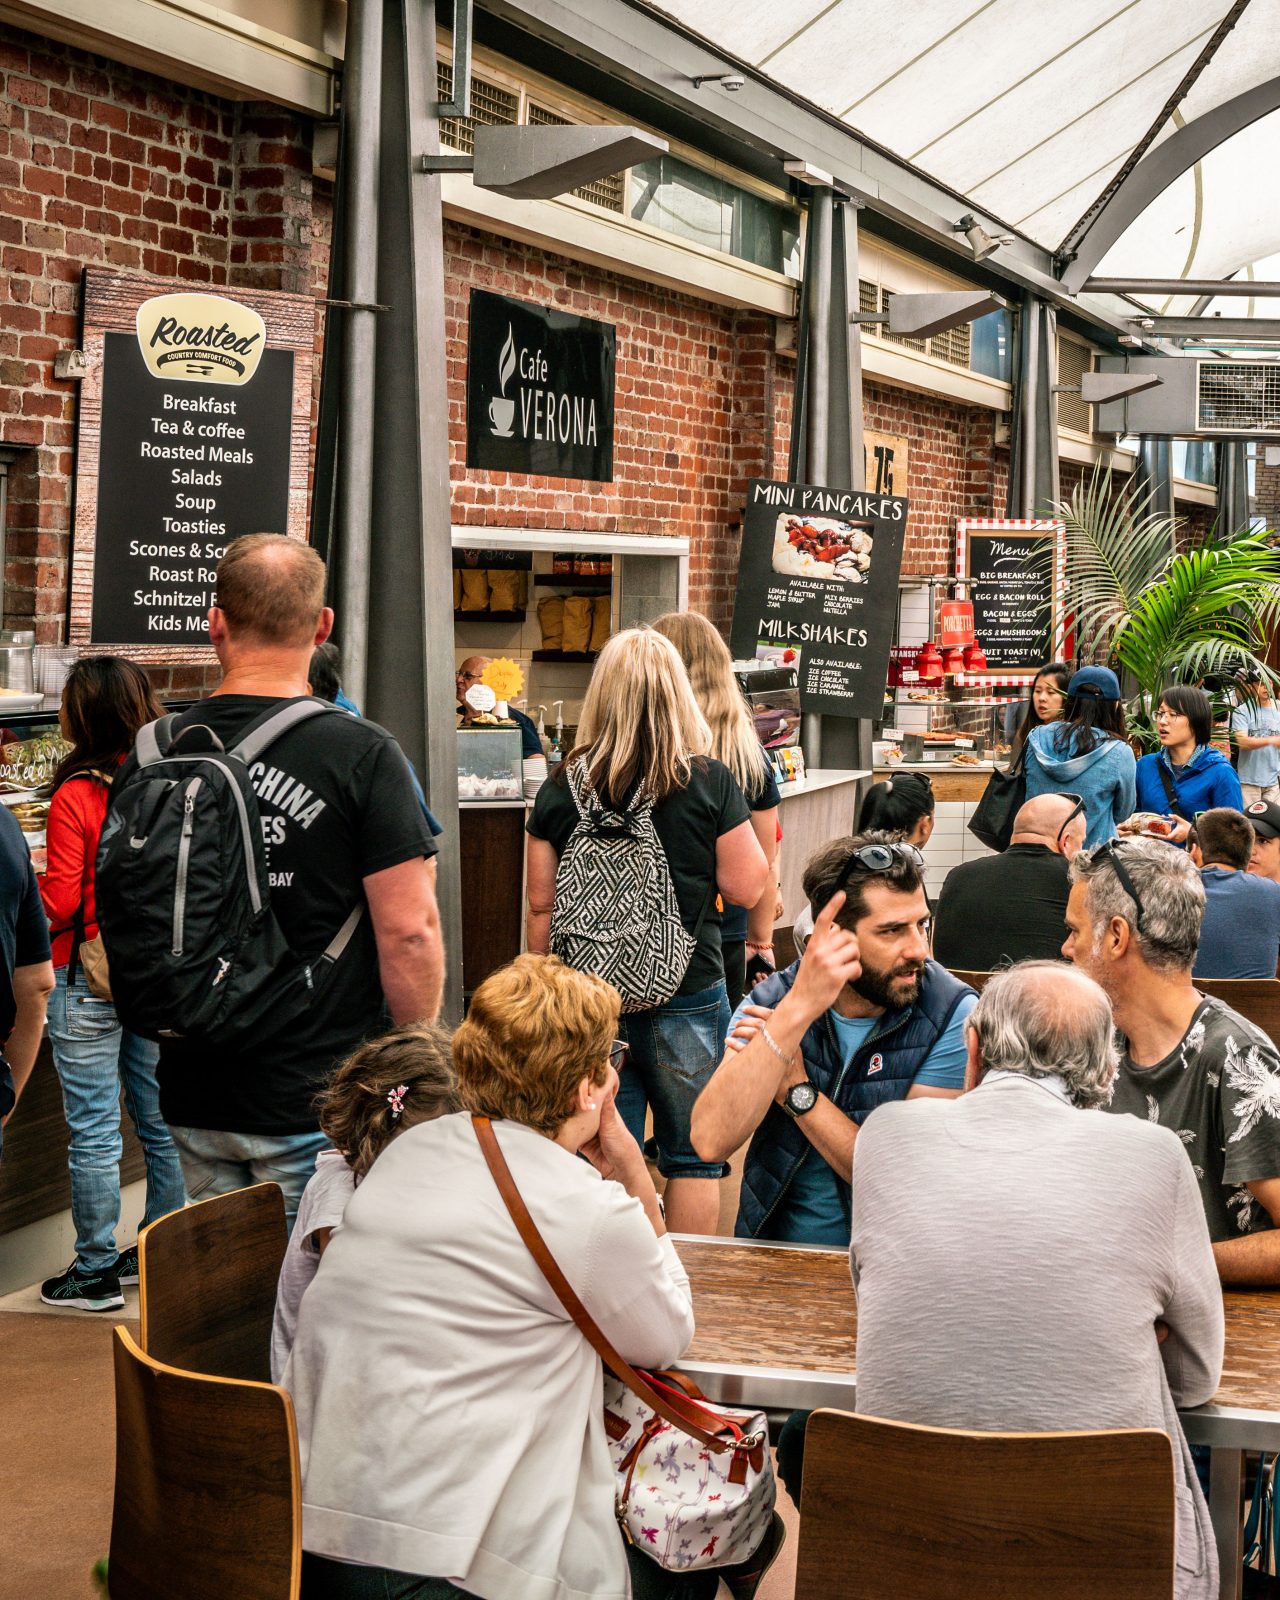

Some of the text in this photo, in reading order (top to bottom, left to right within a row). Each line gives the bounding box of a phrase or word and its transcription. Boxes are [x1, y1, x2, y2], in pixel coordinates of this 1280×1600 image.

[150, 316, 261, 356] Roasted
[167, 351, 236, 367] COUNTRY COMFORT FOOD
[519, 347, 548, 382] Cafe
[163, 394, 237, 415] Breakfast
[520, 387, 597, 447] VERONA
[151, 417, 246, 440] Tea & coffee
[140, 441, 254, 464] Roasted Meals
[171, 468, 222, 486] Salads
[175, 493, 216, 514] Soup
[754, 484, 903, 521] MINI PANCAKES
[162, 517, 226, 535] Toasties
[129, 540, 186, 558] Scones
[189, 542, 202, 558] &
[989, 540, 1032, 556] Menu
[149, 566, 218, 583] Roast Ro
[789, 580, 824, 590] AVAILABLE
[133, 590, 207, 607] Schnitzel
[794, 591, 816, 599] BUTTER
[824, 601, 852, 609] CHOCOLATE
[982, 610, 1038, 618] BACON & EGGS
[148, 615, 210, 632] Kids Me
[943, 615, 973, 632] PORCHETTA
[758, 618, 868, 648] MILKSHAKES
[982, 648, 1041, 656] RUIT TOAST (V)
[808, 658, 824, 666] ALSO
[820, 676, 849, 684] CHOCOLATE
[821, 669, 842, 677] COFFEE
[818, 688, 854, 698] STRAWBERRY
[819, 682, 845, 690] CARAMEL
[0, 754, 37, 782] oasted
[248, 762, 326, 830] CHINA
[268, 872, 295, 887] BAY
